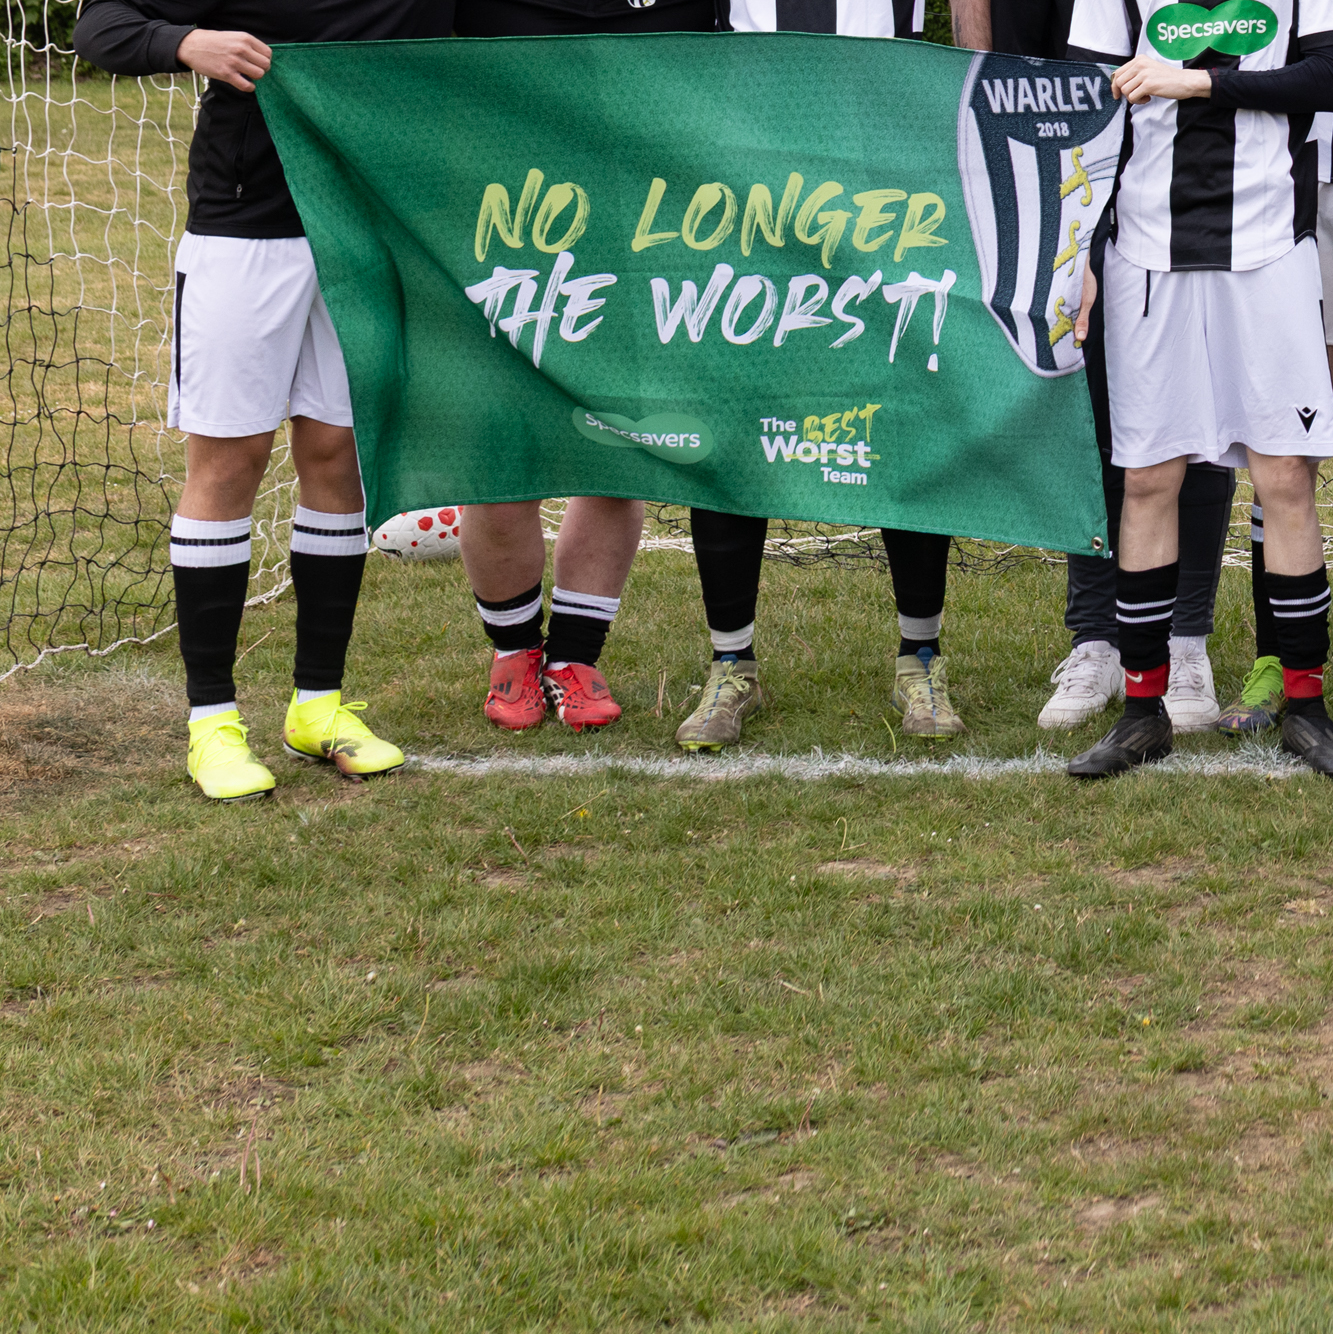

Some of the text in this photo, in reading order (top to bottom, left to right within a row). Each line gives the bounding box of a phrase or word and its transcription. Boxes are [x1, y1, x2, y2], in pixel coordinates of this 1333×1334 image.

[1157, 18, 1266, 43] Specsavers
[981, 76, 1103, 113] WARLEY
[1036, 122, 1069, 137] 2018
[475, 168, 949, 268] NO LONGER
[465, 251, 956, 371] THE WORST!
[585, 413, 700, 447] Specsavers
[760, 403, 882, 446] The BEST
[760, 435, 871, 468] Worst
[820, 467, 867, 485] Team
